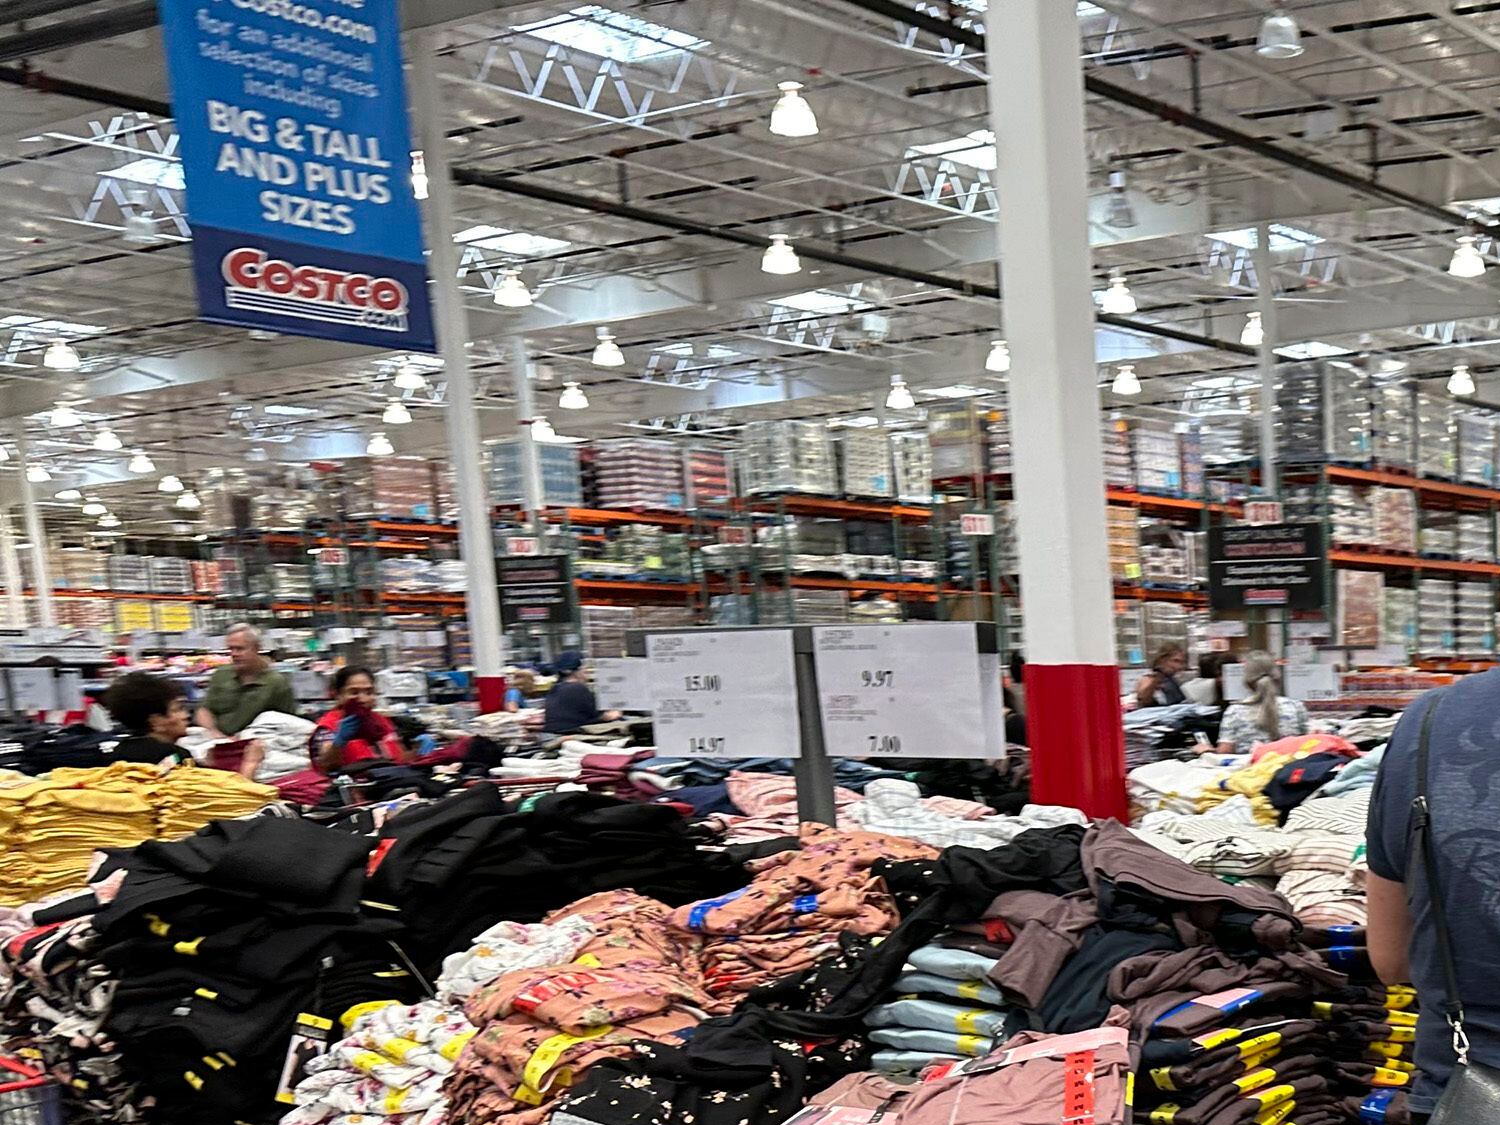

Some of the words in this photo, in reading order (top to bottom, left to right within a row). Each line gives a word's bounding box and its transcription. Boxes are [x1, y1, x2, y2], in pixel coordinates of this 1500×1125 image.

[231, 0, 377, 43] ostco.com
[206, 99, 271, 143] BIG
[274, 116, 306, 152] &
[304, 123, 393, 168] TALL
[216, 143, 299, 187] AND
[303, 161, 393, 205] PLUS
[259, 190, 357, 235] SIZES
[223, 248, 408, 313] COSTCO
[684, 675, 722, 692] 15.00
[861, 670, 894, 688] 9.97
[690, 736, 726, 753] 14.97
[868, 735, 902, 753] 7.00
